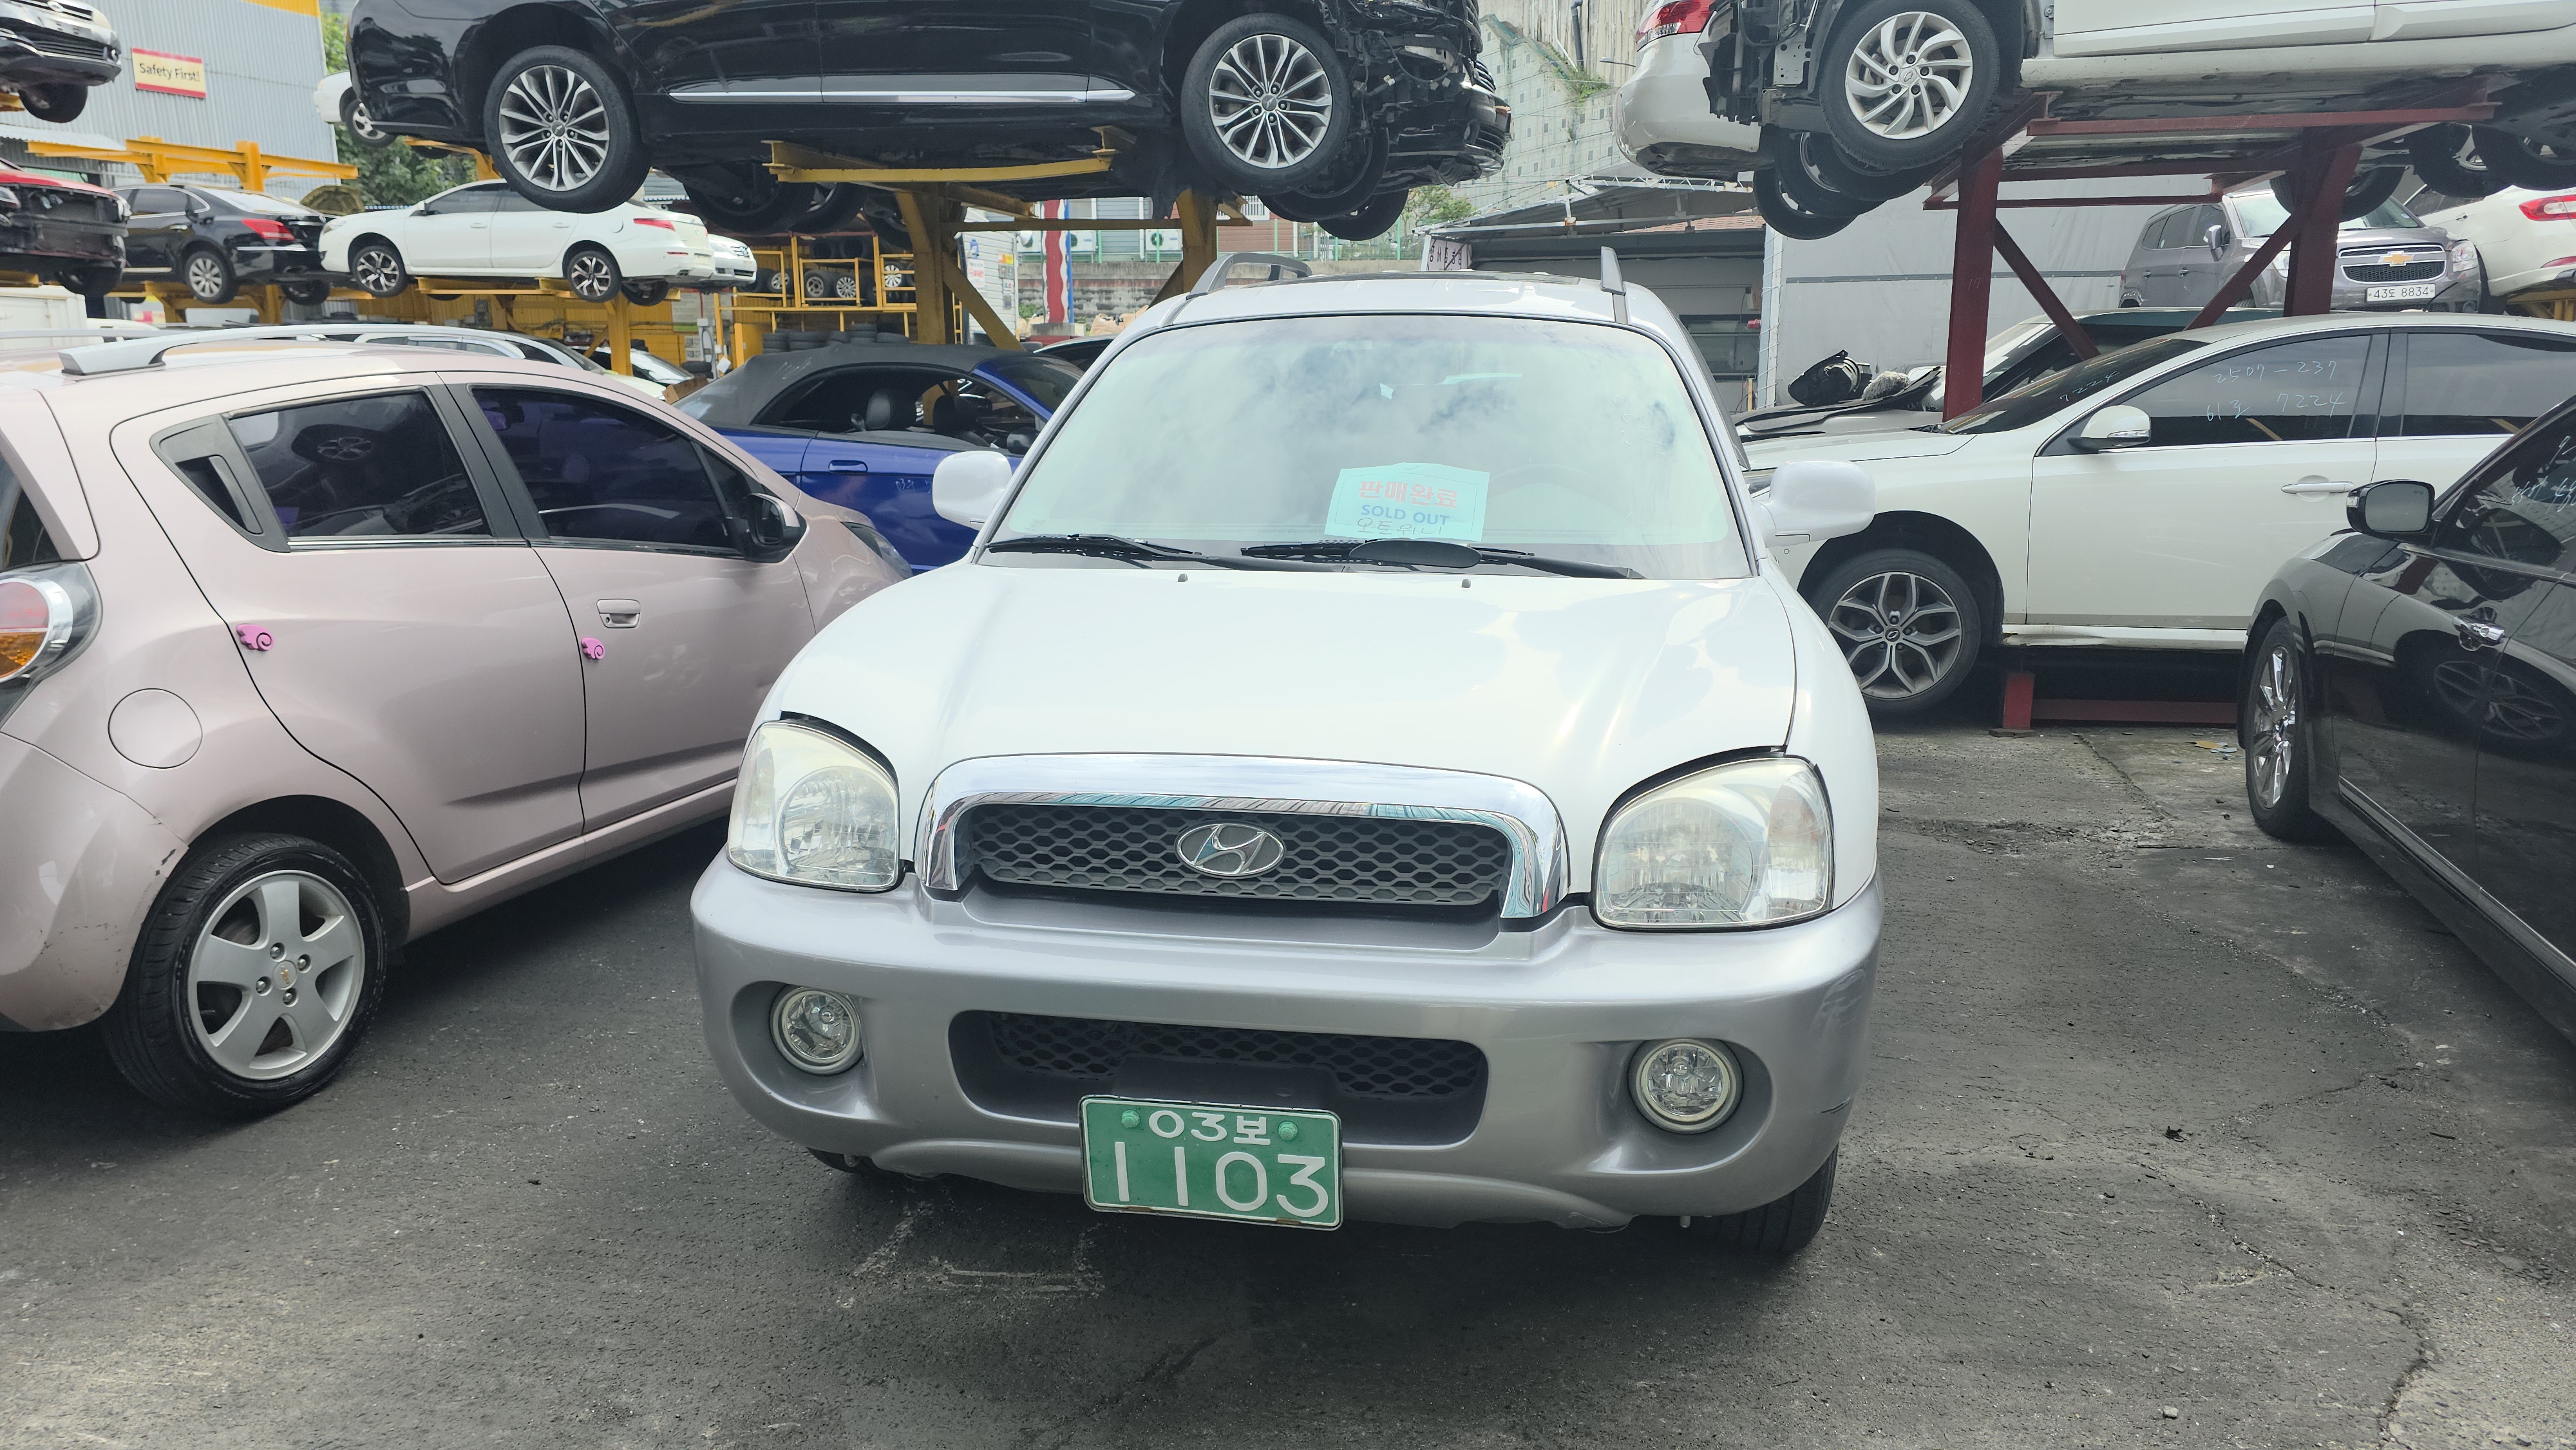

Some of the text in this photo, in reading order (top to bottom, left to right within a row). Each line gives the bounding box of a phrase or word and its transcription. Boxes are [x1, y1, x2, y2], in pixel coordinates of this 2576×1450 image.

[140, 63, 200, 81] Safety First!
[2374, 287, 2428, 298] 43도 8834
[2277, 391, 2346, 418] 7224
[1359, 480, 1457, 508] 판매완료
[1361, 504, 1450, 526] SOLD OUT
[1148, 1109, 1271, 1145] 03보
[1114, 1141, 1329, 1218] 1103
